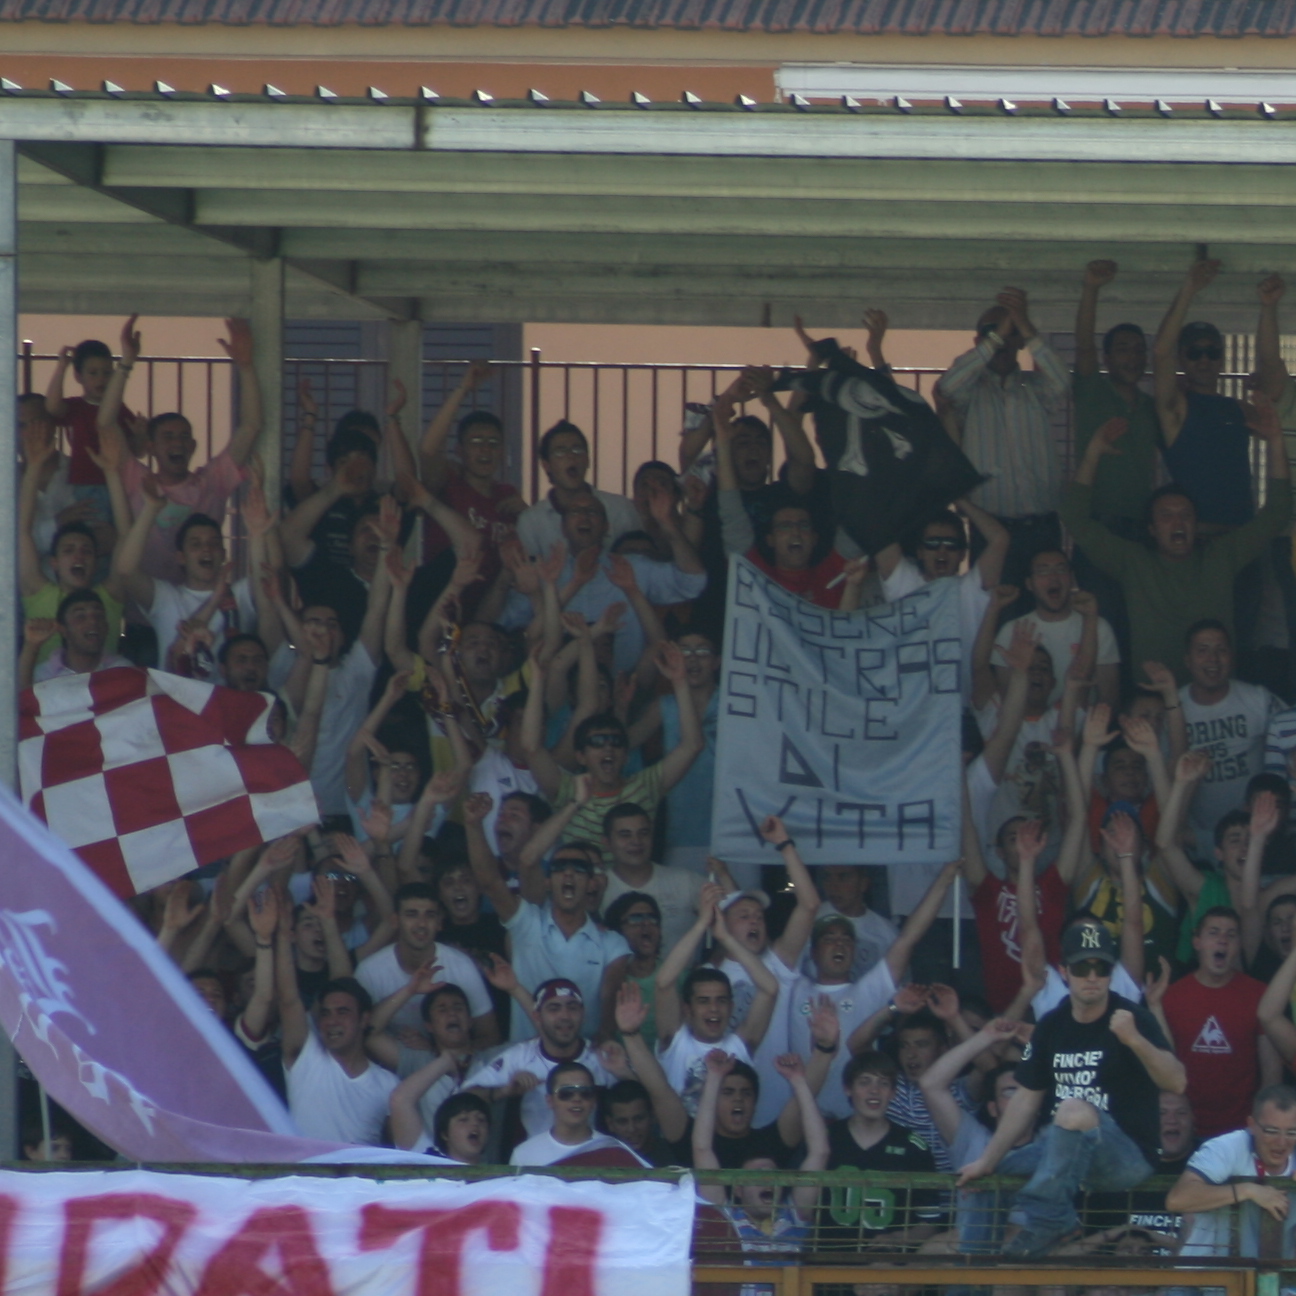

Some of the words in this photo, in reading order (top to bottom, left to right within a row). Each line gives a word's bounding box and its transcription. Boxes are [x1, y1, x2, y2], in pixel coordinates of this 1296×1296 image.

[735, 562, 931, 639] ESSERE
[731, 637, 961, 699] ULTRAS
[727, 670, 899, 742] STILE
[734, 787, 936, 851] VITA
